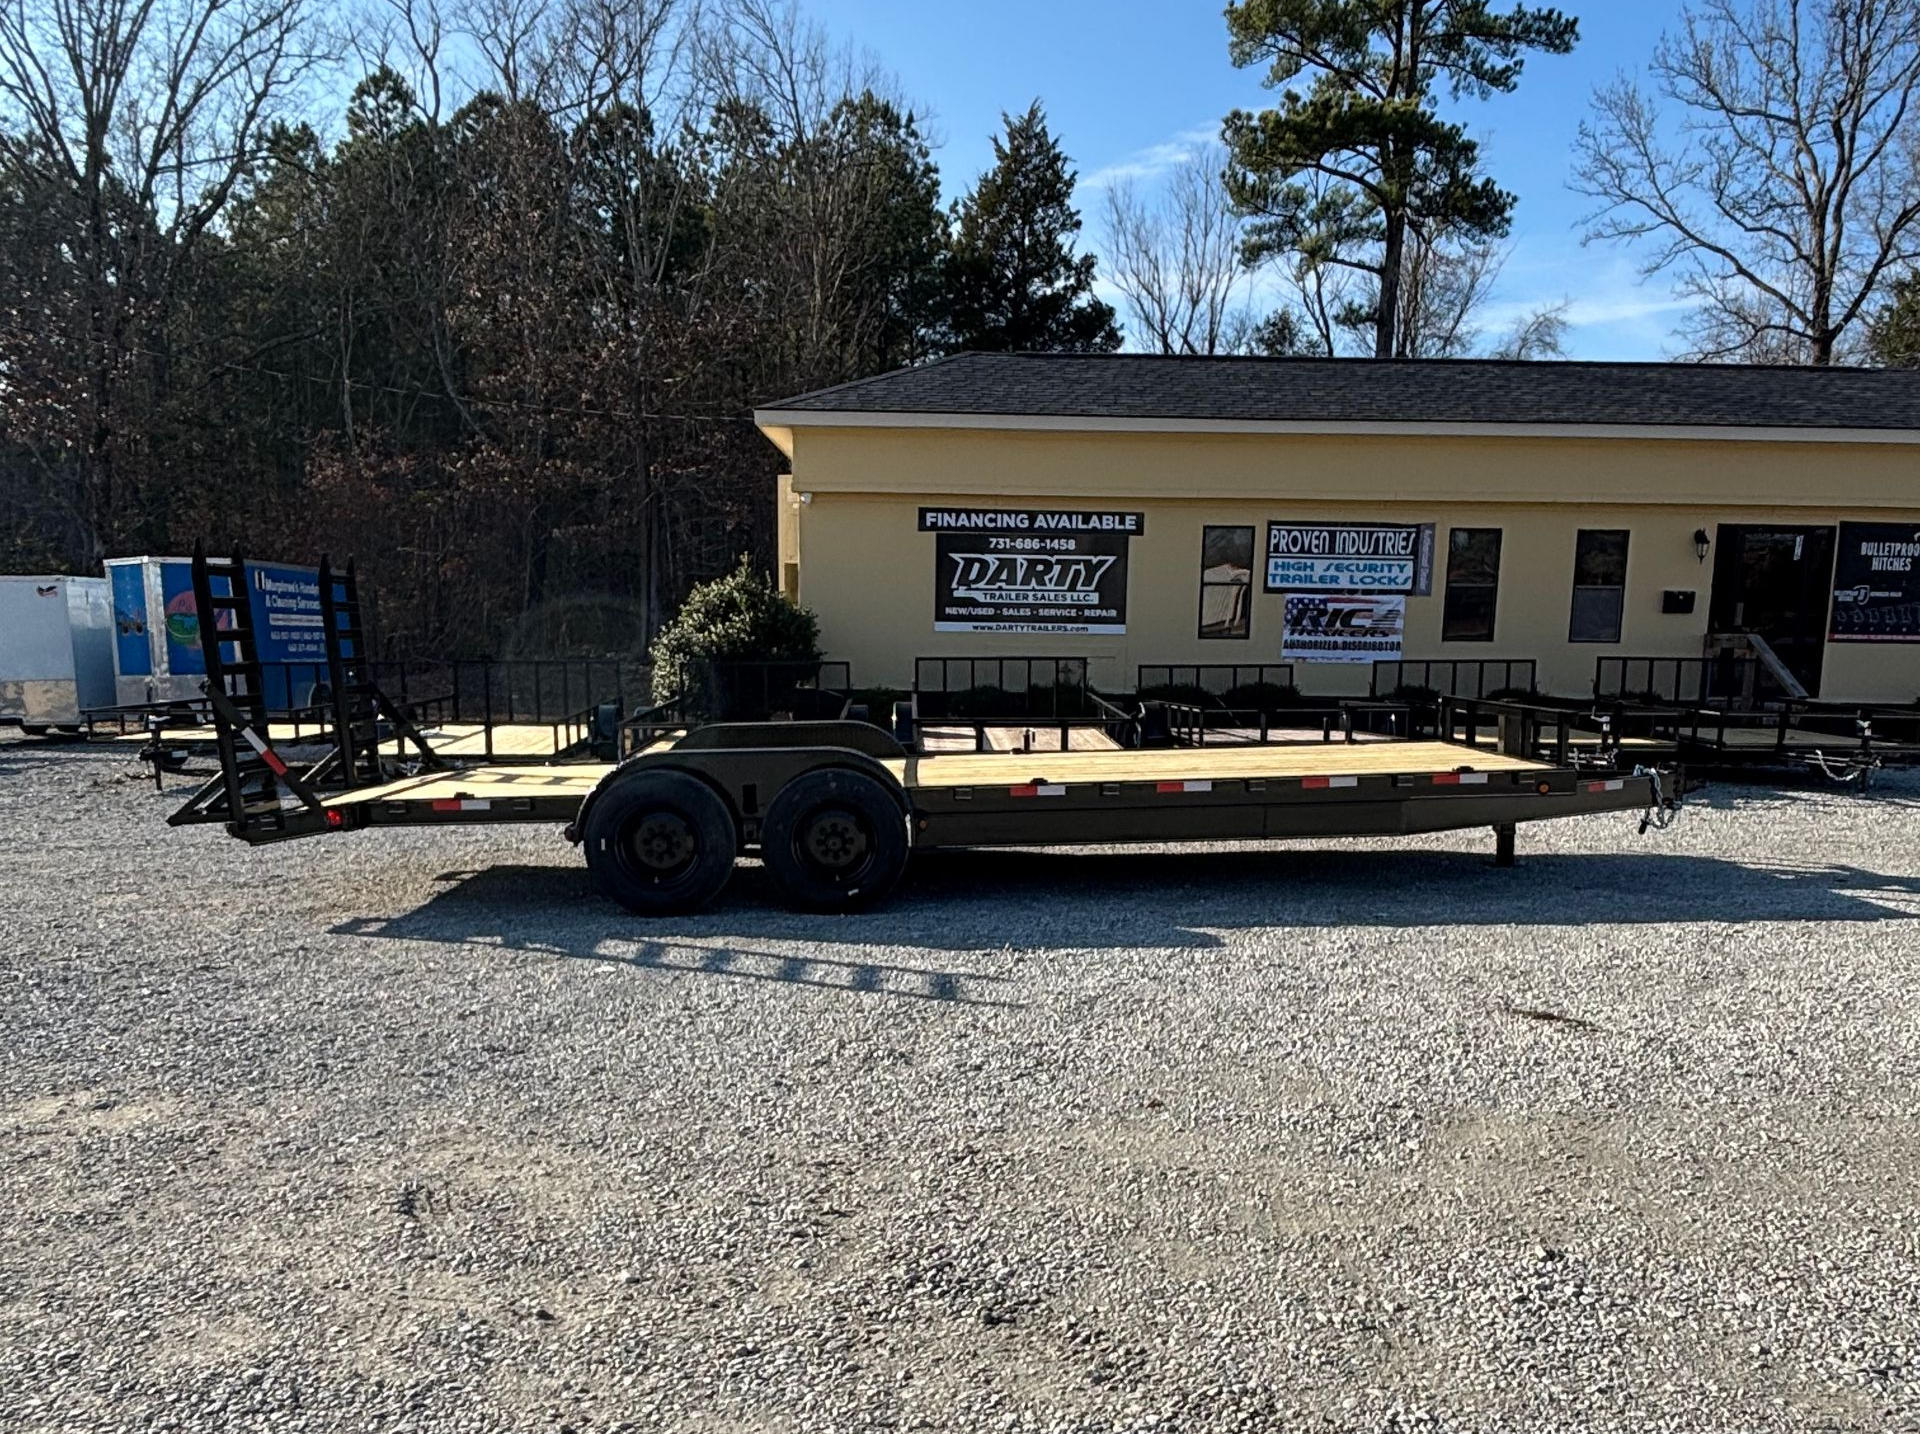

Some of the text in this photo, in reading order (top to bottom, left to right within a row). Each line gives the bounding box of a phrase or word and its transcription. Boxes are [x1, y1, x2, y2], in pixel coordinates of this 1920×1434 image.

[925, 512, 1137, 530] FINANCING AVAILABLE
[989, 538, 1076, 550] 731-686-1458
[1270, 530, 1416, 555] PROVEN INDUSTRIES
[1860, 541, 1920, 557] BULLETPROO
[1273, 561, 1409, 573] HIGH SECURITY
[1872, 557, 1912, 571] HITCHES
[948, 553, 1117, 591] DARTY
[1269, 573, 1412, 586] TRAILER LOCKS
[983, 593, 1029, 602] TRAILER
[1032, 593, 1067, 602] SALES
[945, 607, 1117, 617] NEW/USED SALES SERVICE REPAIR
[1283, 639, 1401, 652] AUTHORIZED DISTRIBUTOR
